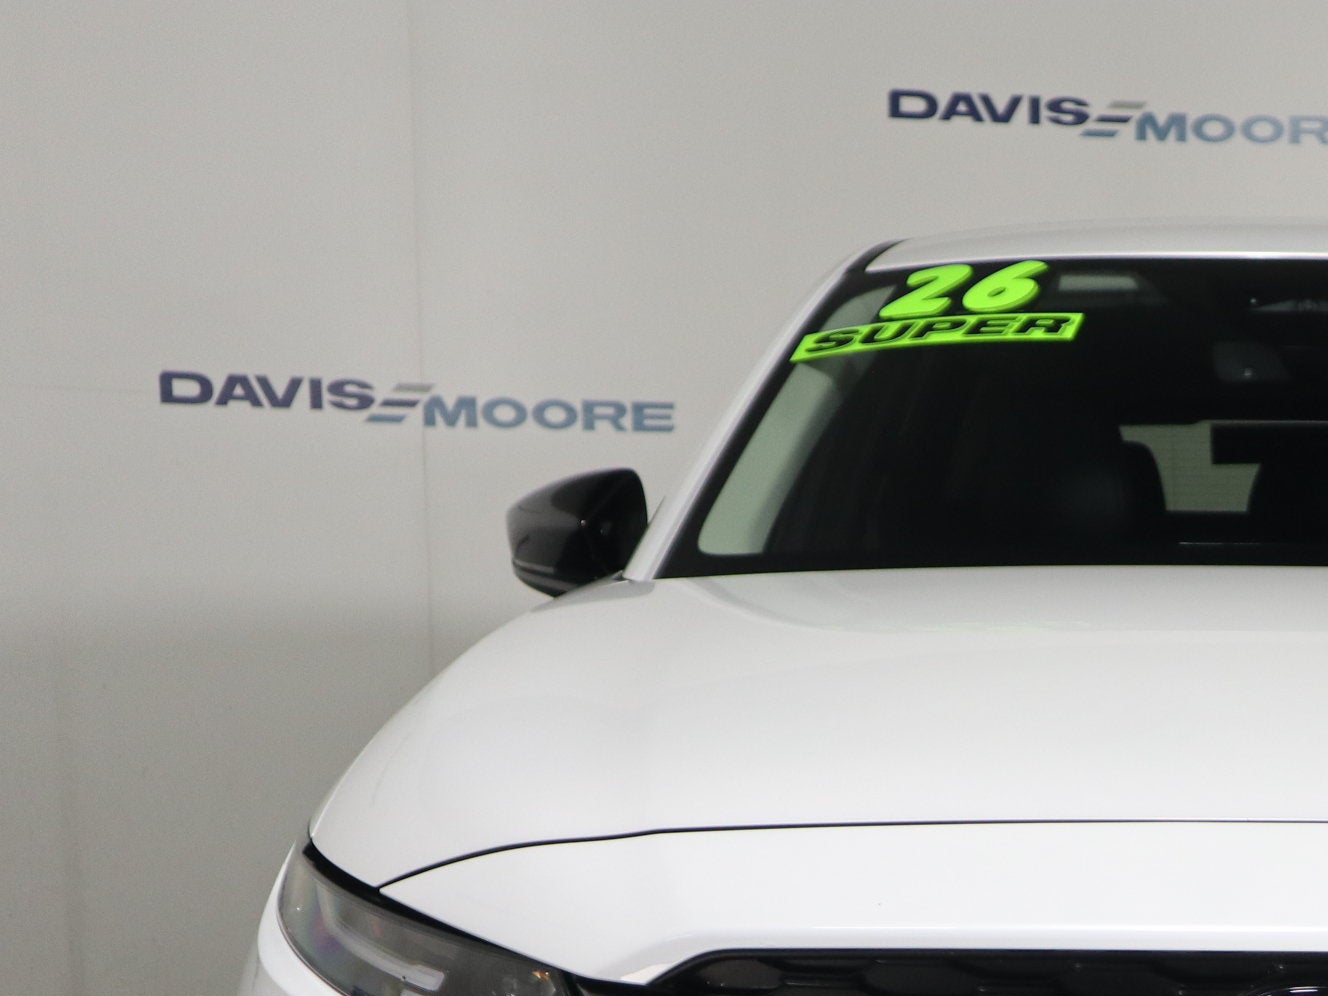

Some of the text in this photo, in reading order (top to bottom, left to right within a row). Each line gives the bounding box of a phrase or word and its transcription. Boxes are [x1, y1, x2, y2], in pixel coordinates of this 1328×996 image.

[887, 88, 1091, 126] DAVIS
[878, 259, 1050, 320] 26
[805, 315, 1072, 352] SUPER
[158, 370, 676, 433] DAVIS MOORE
